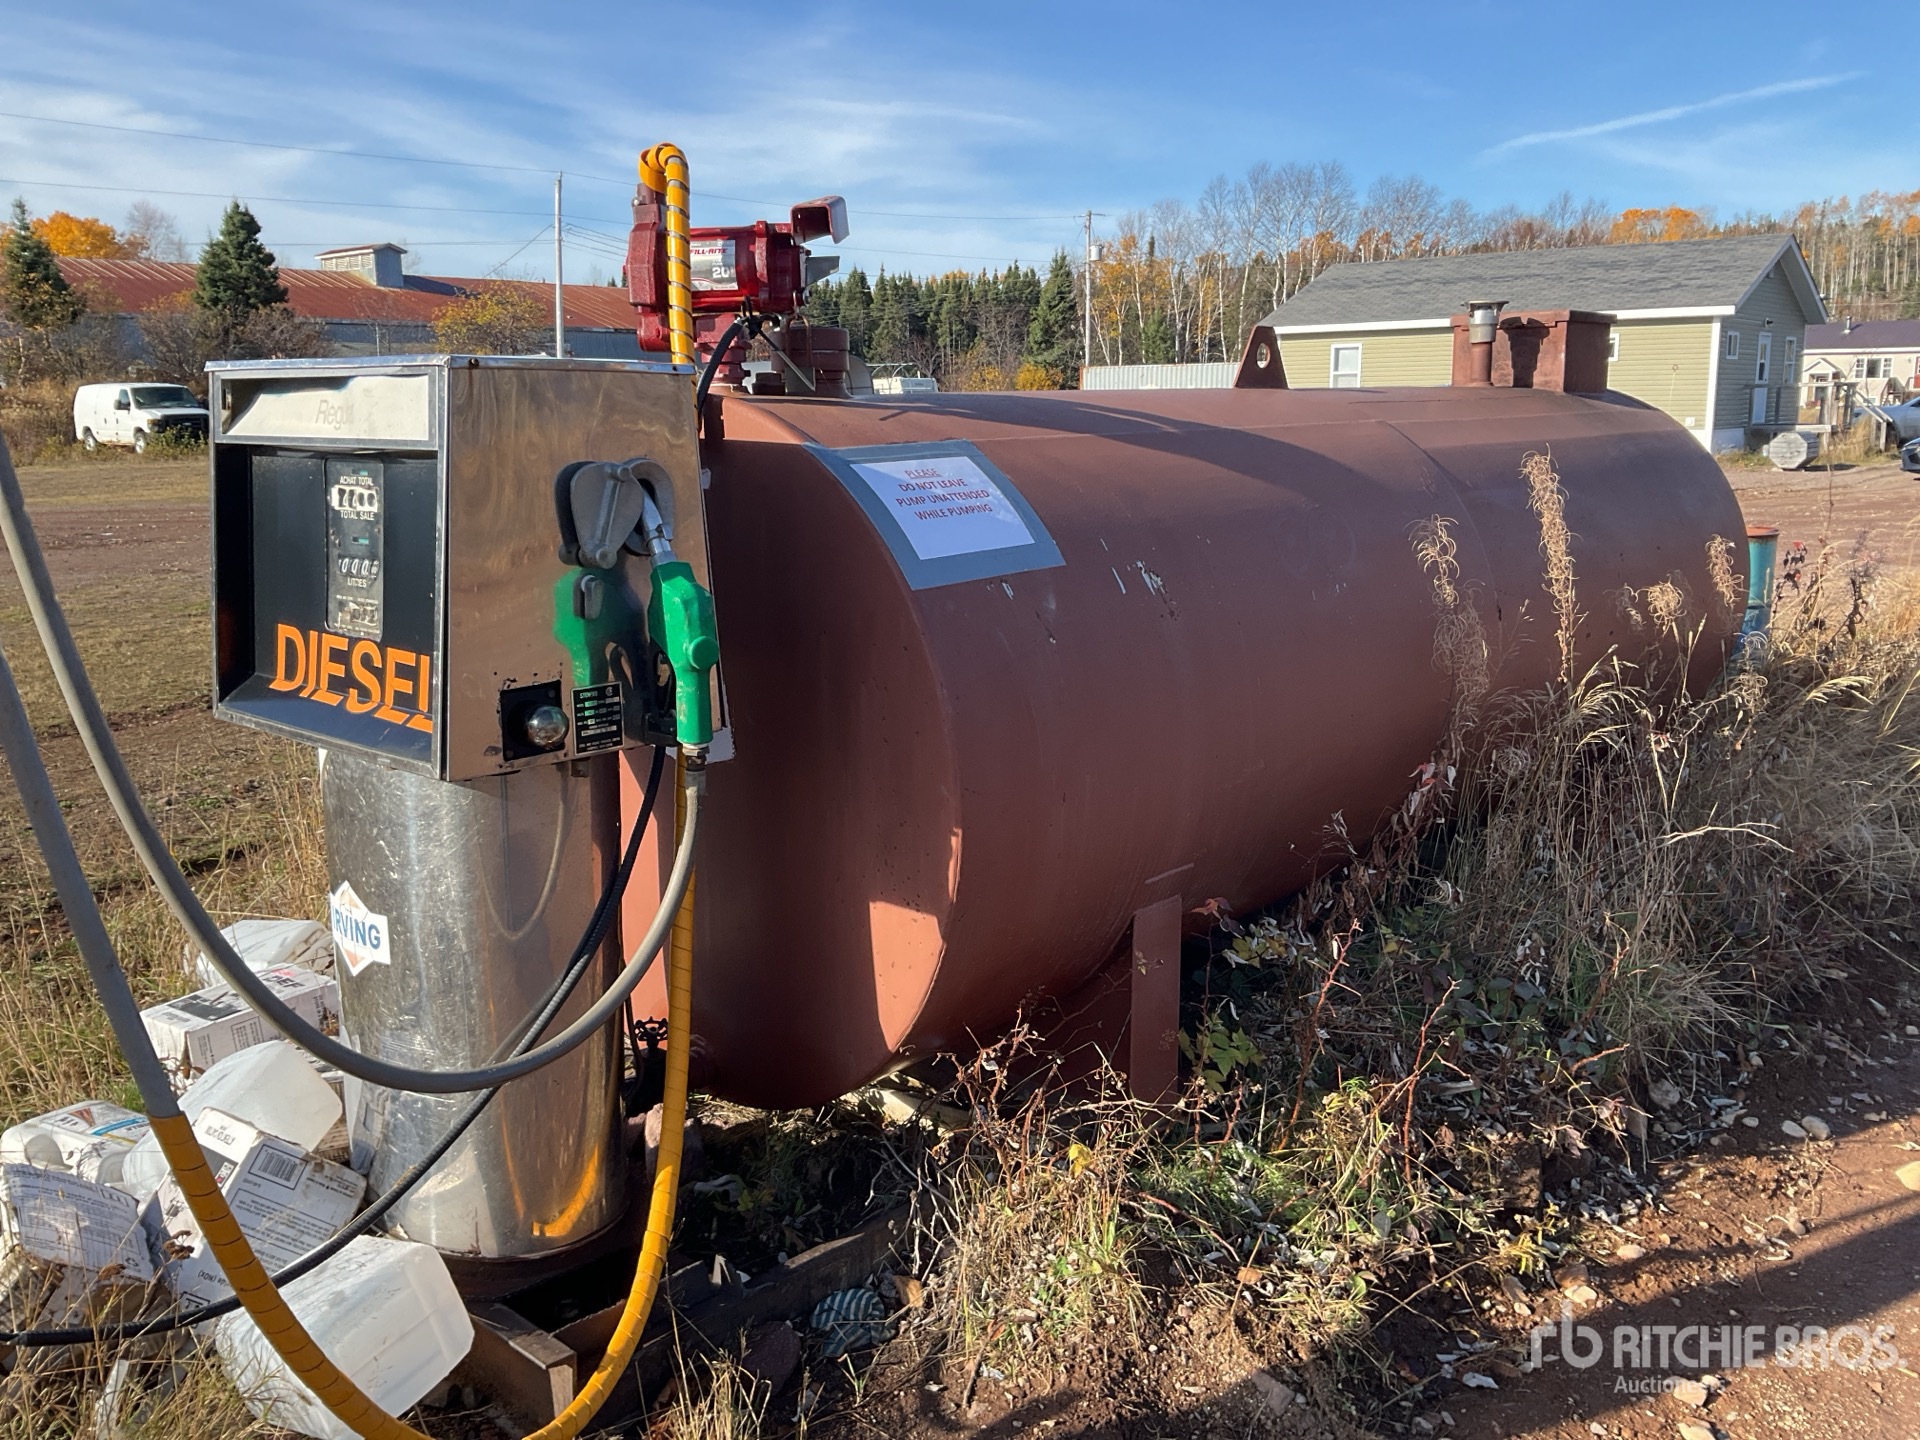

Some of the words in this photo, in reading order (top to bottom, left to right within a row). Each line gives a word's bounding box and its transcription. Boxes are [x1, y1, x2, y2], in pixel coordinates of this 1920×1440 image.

[340, 475, 357, 485] ACHAT
[357, 476, 374, 486] TOTAL
[904, 468, 942, 479] PLEASE
[898, 483, 916, 492] DO
[915, 481, 938, 491] NOT
[937, 478, 968, 488] LEAVE
[895, 496, 927, 507] PUMP
[927, 489, 990, 504] UNATTENDED
[340, 510, 358, 519] TOTAL
[359, 511, 375, 521] SALE
[914, 508, 948, 520] WHILE
[947, 503, 993, 516] PUMPING
[269, 623, 433, 734] DIESEL
[331, 905, 381, 950] IRVING
